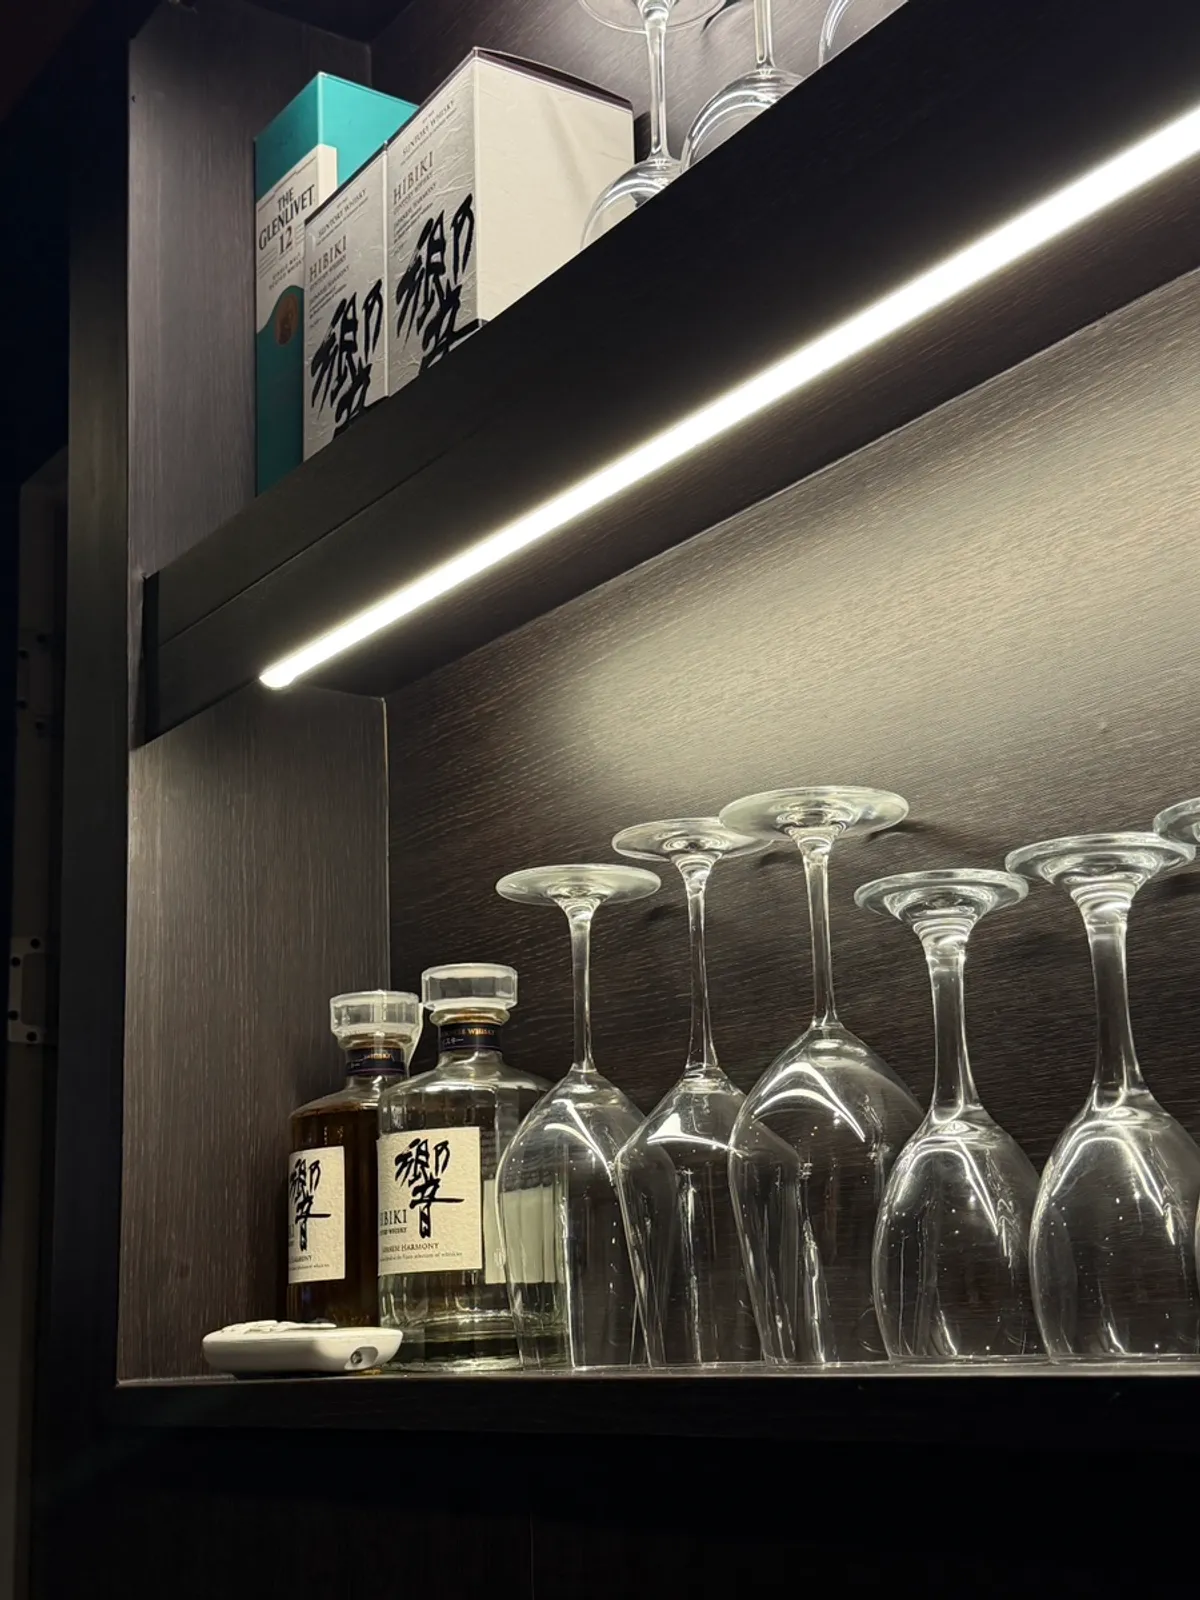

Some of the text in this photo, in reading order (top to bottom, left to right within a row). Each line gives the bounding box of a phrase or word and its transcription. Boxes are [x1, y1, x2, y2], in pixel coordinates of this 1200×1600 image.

[278, 187, 294, 211] THE
[393, 151, 433, 206] HIBIKI
[259, 184, 315, 251] GLENLIVET
[279, 225, 293, 255] 12
[309, 234, 347, 283] HIBIKI
[289, 1158, 332, 1252] 響
[394, 1138, 465, 1239] 響
[401, 1243, 440, 1252] HARMONY
